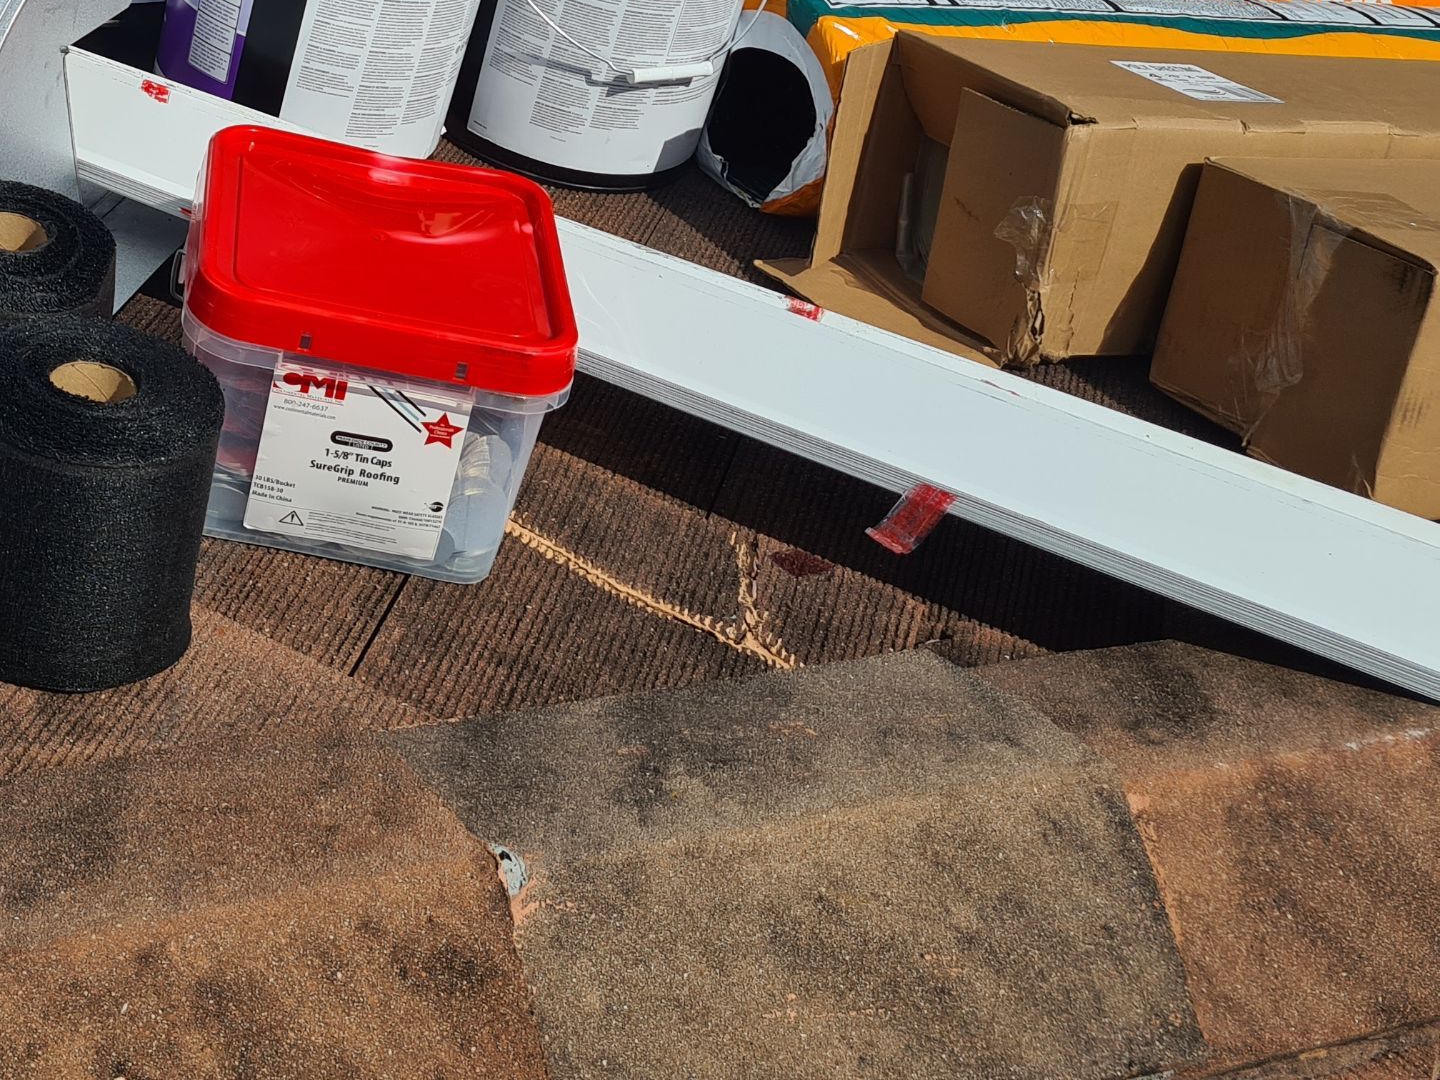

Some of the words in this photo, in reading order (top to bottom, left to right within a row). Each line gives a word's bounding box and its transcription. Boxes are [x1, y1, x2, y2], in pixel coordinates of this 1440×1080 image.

[355, 453, 370, 464] Tin
[370, 456, 393, 469] Caps
[309, 459, 356, 476] SureGrip
[359, 469, 401, 486] Roofing
[337, 476, 369, 488] PREMIUM
[276, 493, 293, 503] China
